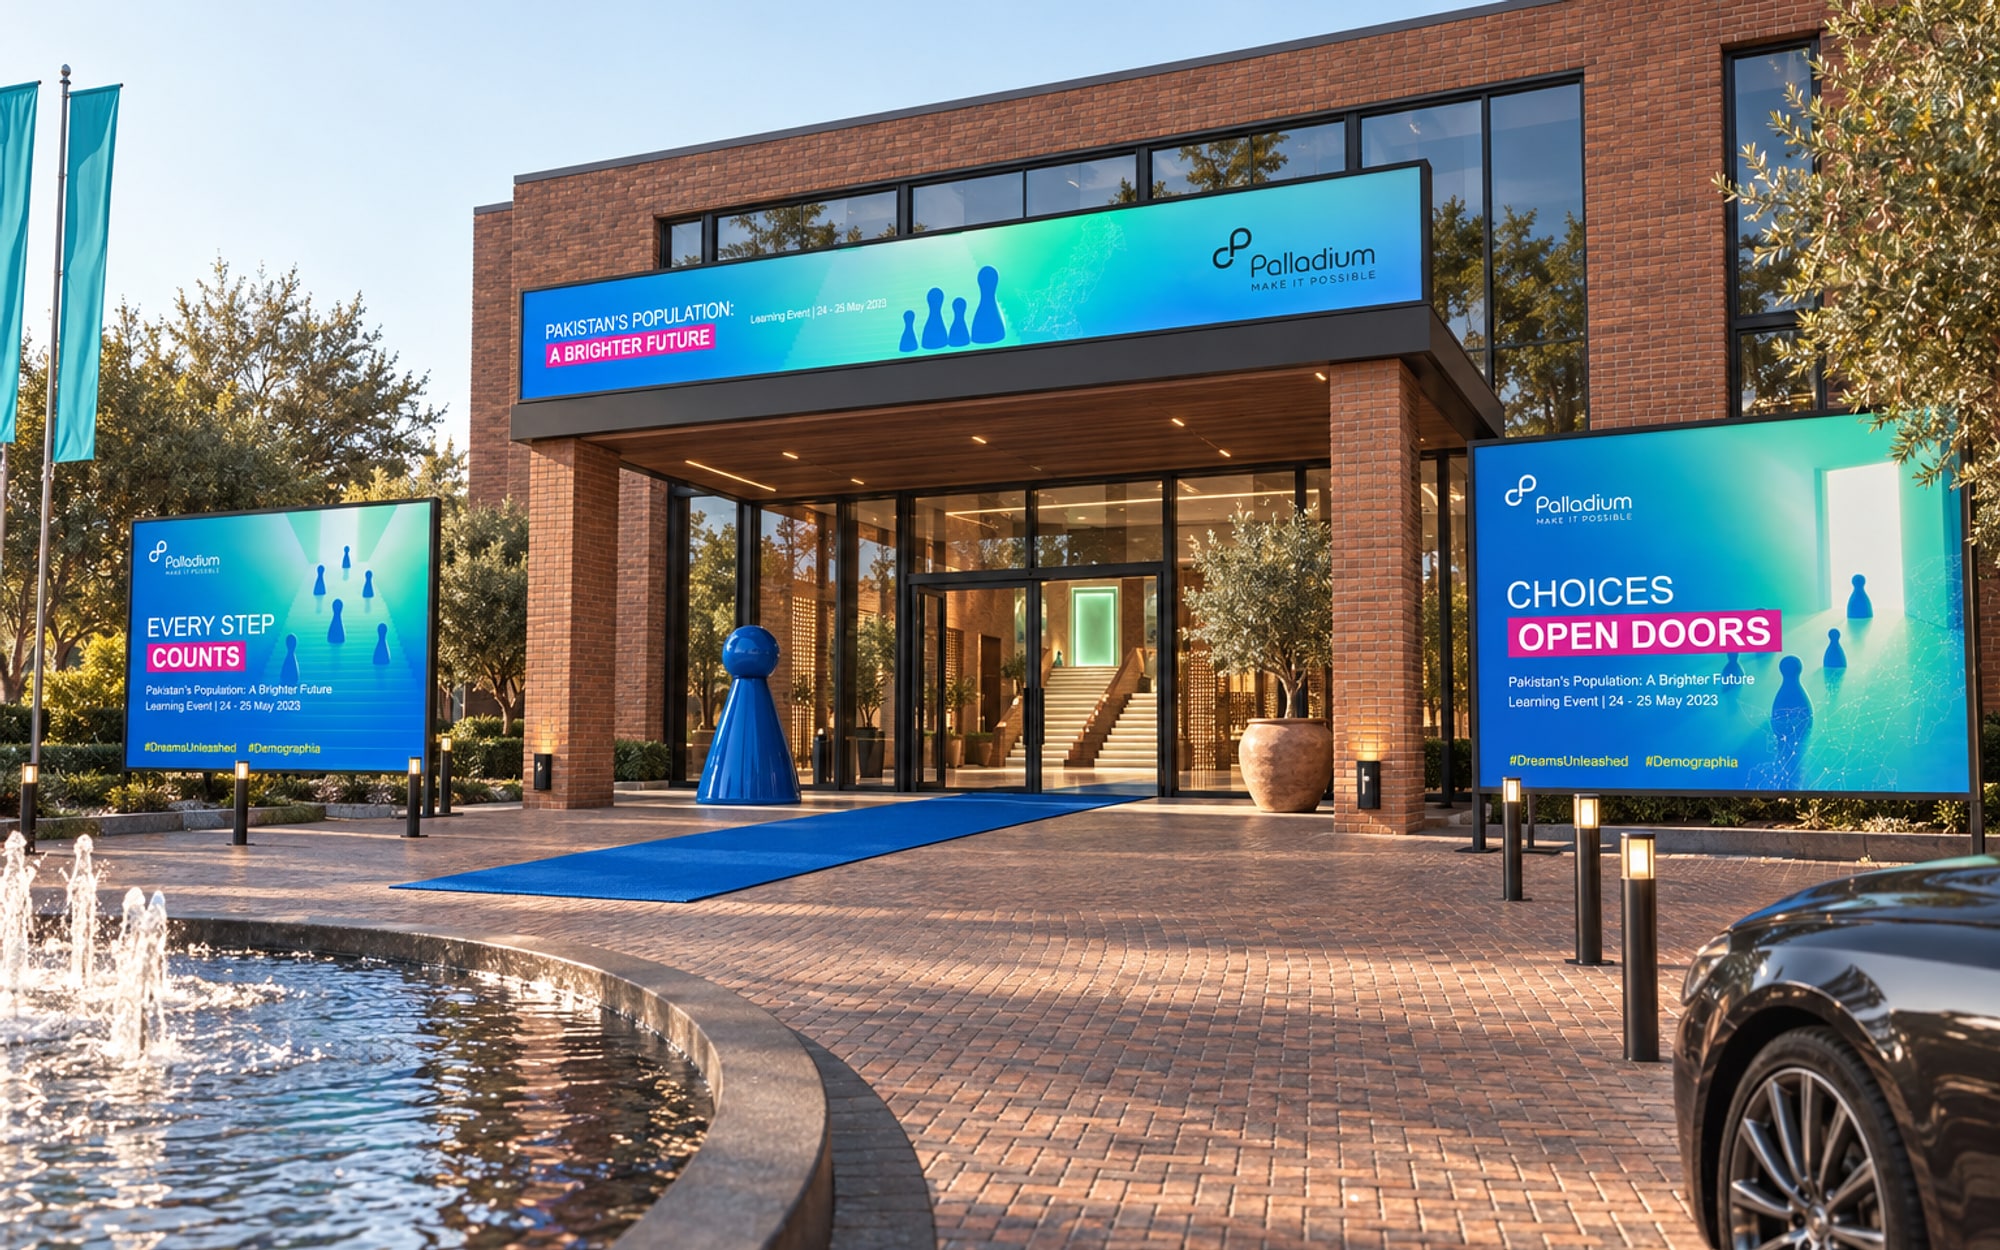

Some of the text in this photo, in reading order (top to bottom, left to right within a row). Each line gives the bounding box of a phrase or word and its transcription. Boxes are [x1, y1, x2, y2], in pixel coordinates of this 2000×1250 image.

[1251, 247, 1375, 278] Palladium
[1252, 270, 1376, 292] MAKE IT POSSIBLE
[545, 301, 735, 340] PAKISTAN'S POPULATION:
[750, 315, 785, 324] Learning
[787, 308, 810, 320] Event
[816, 305, 827, 316] 24
[847, 302, 864, 313] May
[549, 329, 710, 364] A BRIGHTER FUTURE
[1536, 494, 1632, 514] Palladium
[1536, 513, 1632, 525] MAKE IT POSSIBLE
[165, 554, 220, 569] Palladium
[1507, 575, 1674, 609] CHOICES
[148, 613, 275, 638] EVERY STEP
[1518, 616, 1771, 651] OPEN DOORS
[152, 646, 240, 668] COUNTS
[146, 684, 332, 697] Pakistan's Population: A Brighter Future
[1509, 674, 1755, 689] Pakistan's Population: A Brighter Future
[145, 701, 185, 713] Learning
[186, 701, 212, 711] Event
[220, 701, 231, 711] 24
[240, 701, 251, 711] 25
[254, 700, 275, 713] May
[276, 700, 301, 711] 2023
[1509, 695, 1560, 709] Learning
[1564, 696, 1598, 706] Event
[1609, 696, 1623, 706] 24
[1637, 695, 1652, 706] 25
[1656, 695, 1682, 709] May
[1687, 695, 1718, 706] 2023
[248, 742, 321, 756] #Demographia
[1509, 755, 1738, 770] #DreamsUnleashed #Demographia
